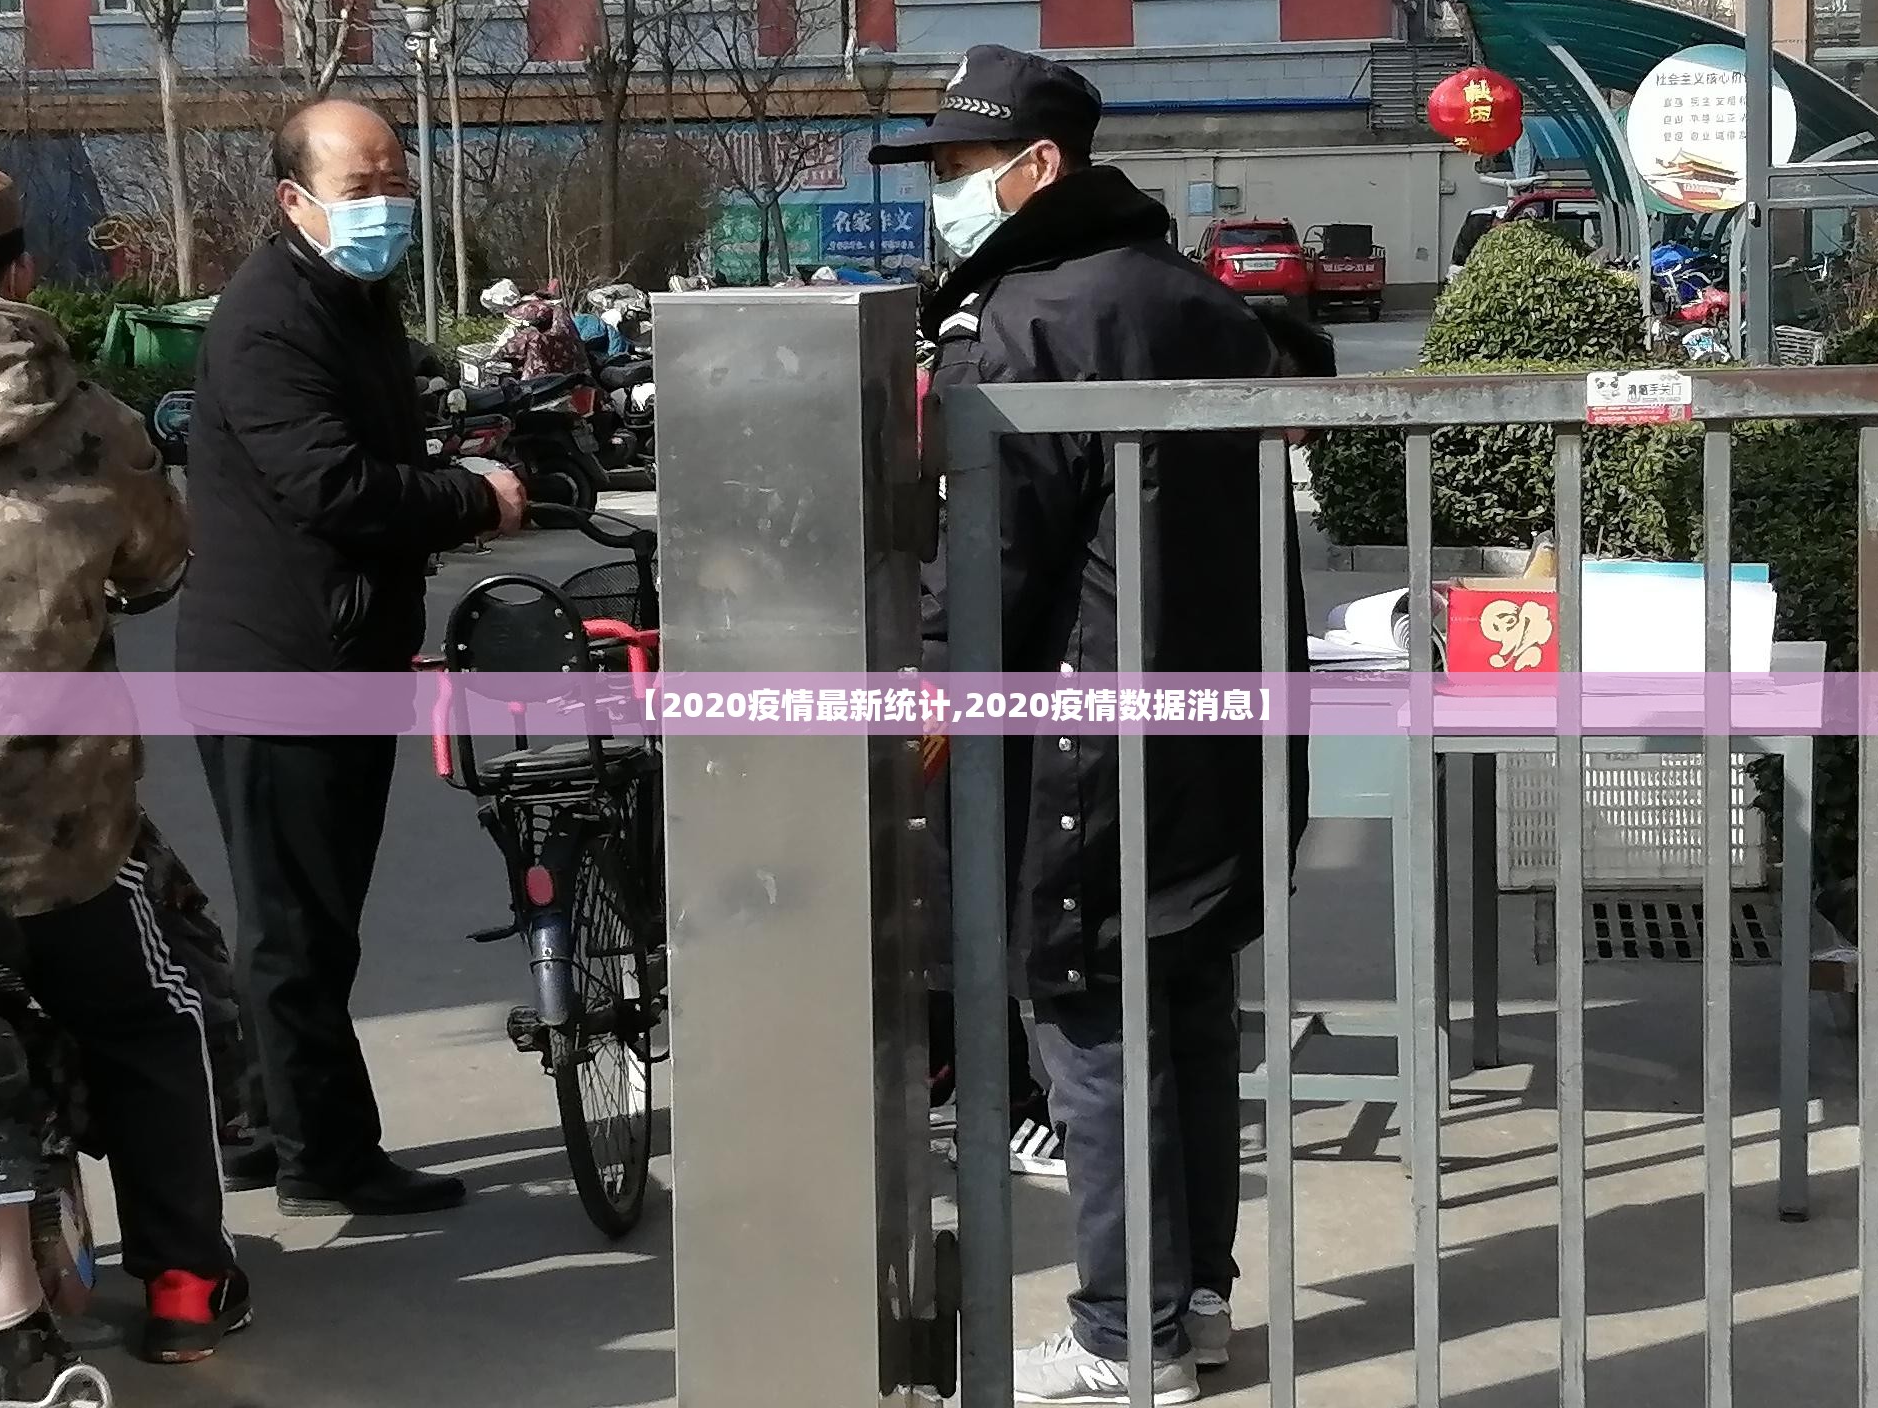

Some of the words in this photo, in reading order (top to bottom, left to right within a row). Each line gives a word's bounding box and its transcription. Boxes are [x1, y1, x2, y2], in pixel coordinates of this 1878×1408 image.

[1656, 71, 1746, 87] 社会主义核心价
